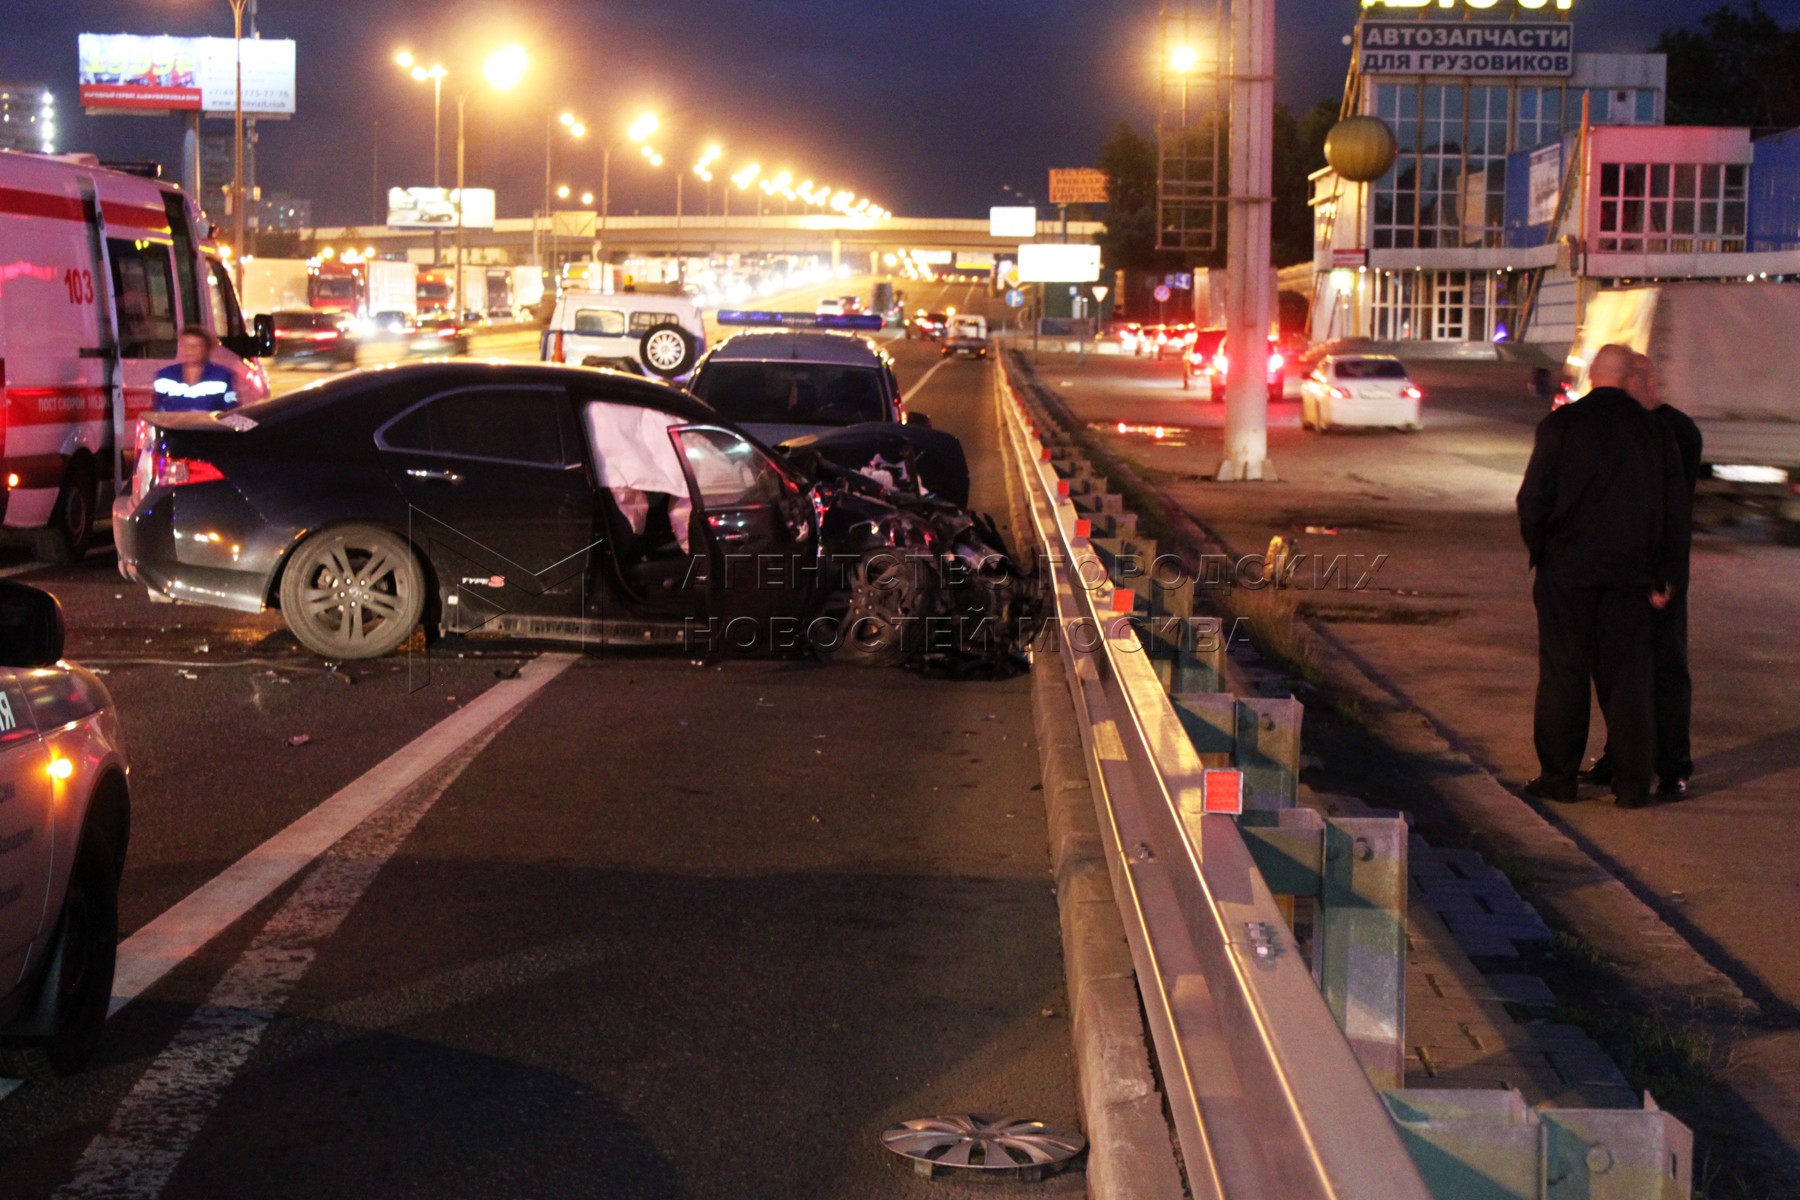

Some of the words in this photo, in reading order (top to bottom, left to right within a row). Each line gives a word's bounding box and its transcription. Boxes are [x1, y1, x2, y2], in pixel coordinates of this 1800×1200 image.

[1365, 28, 1569, 48] АВТОЗАПЧАСТИ
[1363, 54, 1410, 72] ДЛЯ
[1418, 54, 1569, 71] ГРУЗОВИКОВ
[64, 268, 95, 305] 103
[38, 398, 58, 413] ПОСТ
[462, 576, 489, 585] TYPE
[488, 575, 506, 588] S
